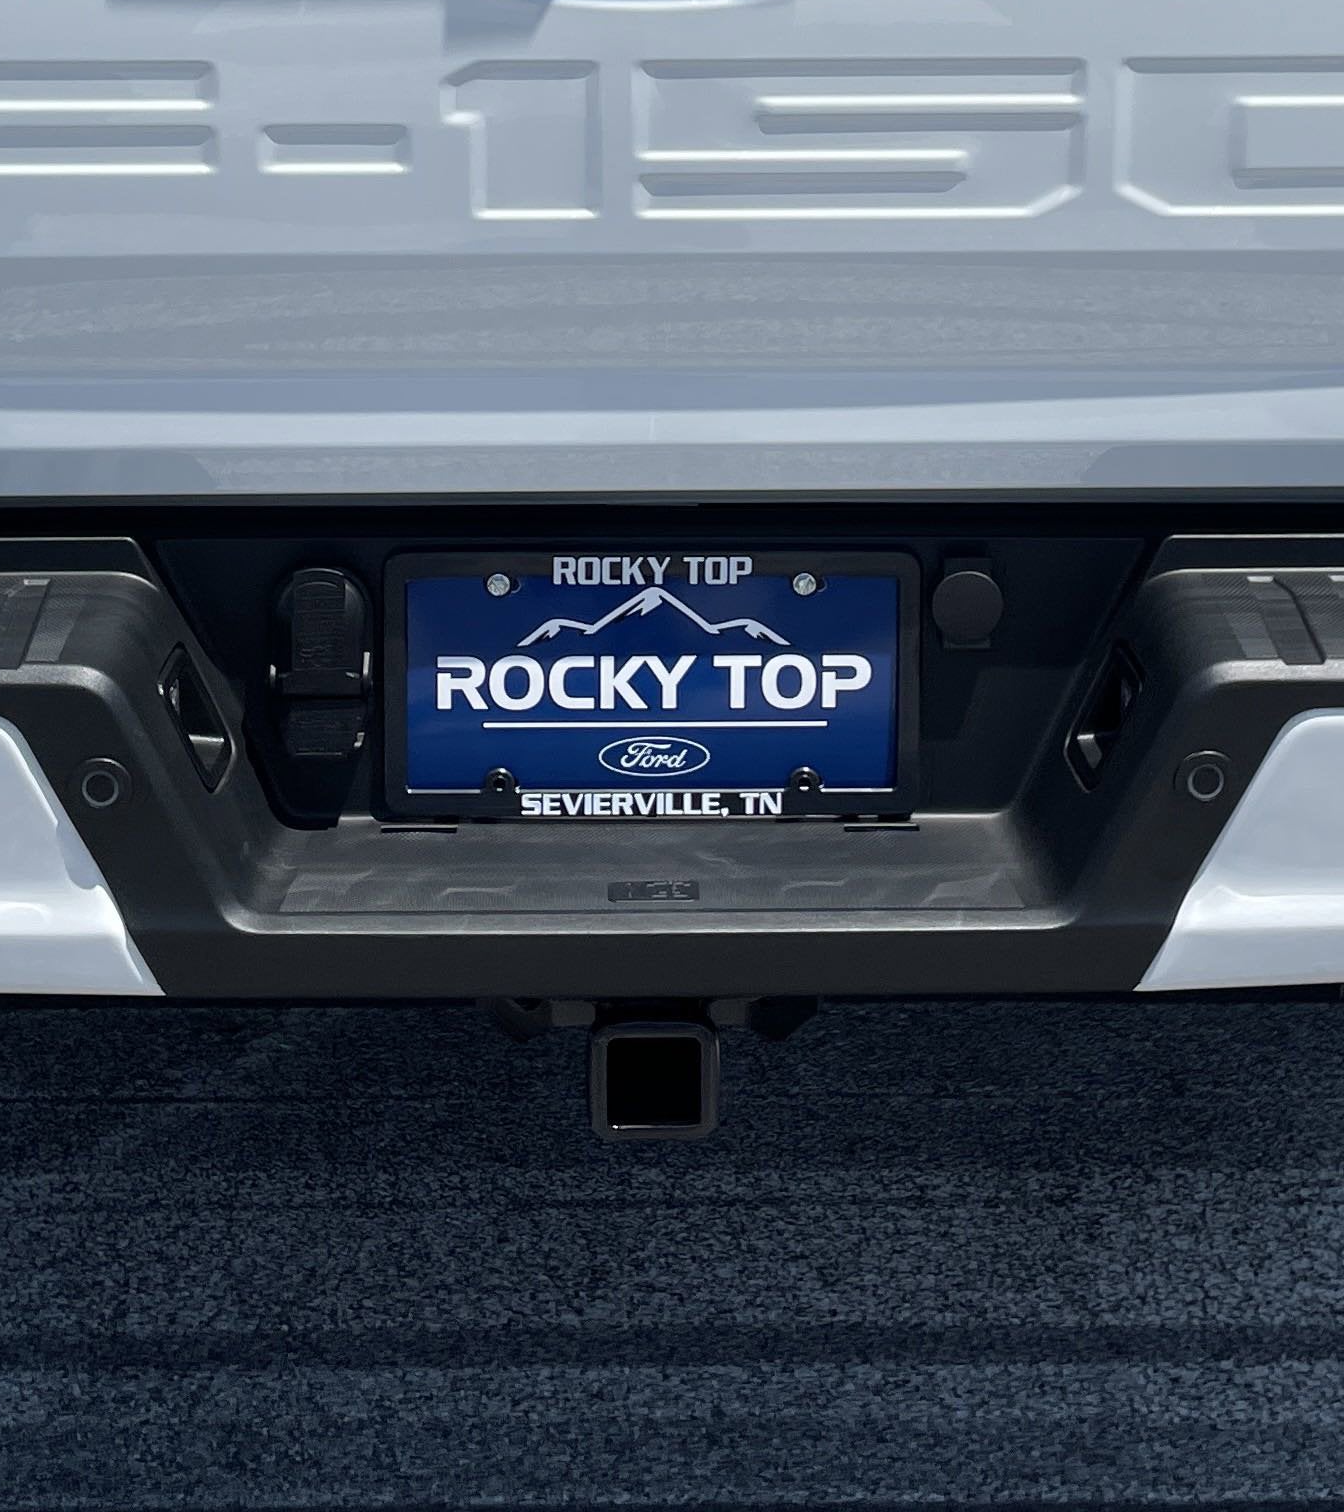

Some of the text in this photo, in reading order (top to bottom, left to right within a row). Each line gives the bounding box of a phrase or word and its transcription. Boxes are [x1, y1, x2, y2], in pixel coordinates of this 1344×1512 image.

[552, 556, 753, 586] ROCKY TOP
[436, 655, 873, 710] ROCKY TOP
[619, 742, 689, 771] Ford
[520, 792, 784, 818] SEVIERVILLE, TN
